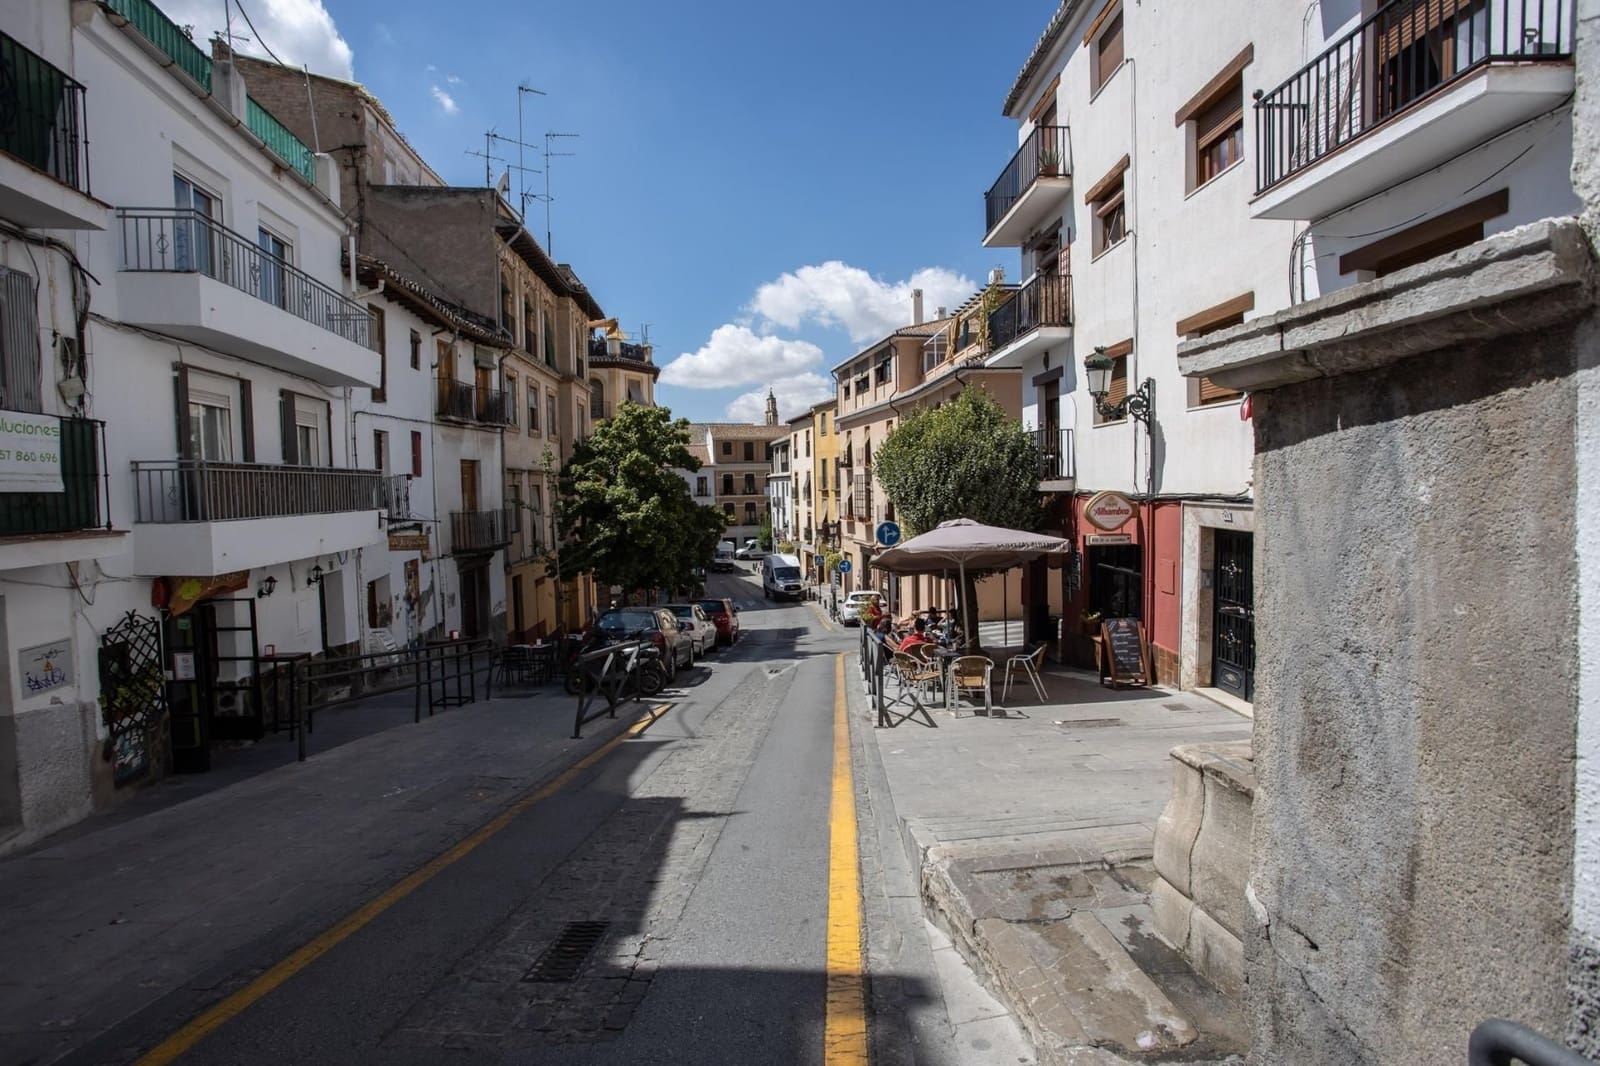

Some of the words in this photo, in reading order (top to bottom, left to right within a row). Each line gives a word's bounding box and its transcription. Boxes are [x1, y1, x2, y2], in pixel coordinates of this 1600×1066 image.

[0, 418, 60, 437] luciones
[16, 451, 37, 462] 860
[39, 452, 58, 463] 696
[1094, 506, 1130, 516] Alhambra
